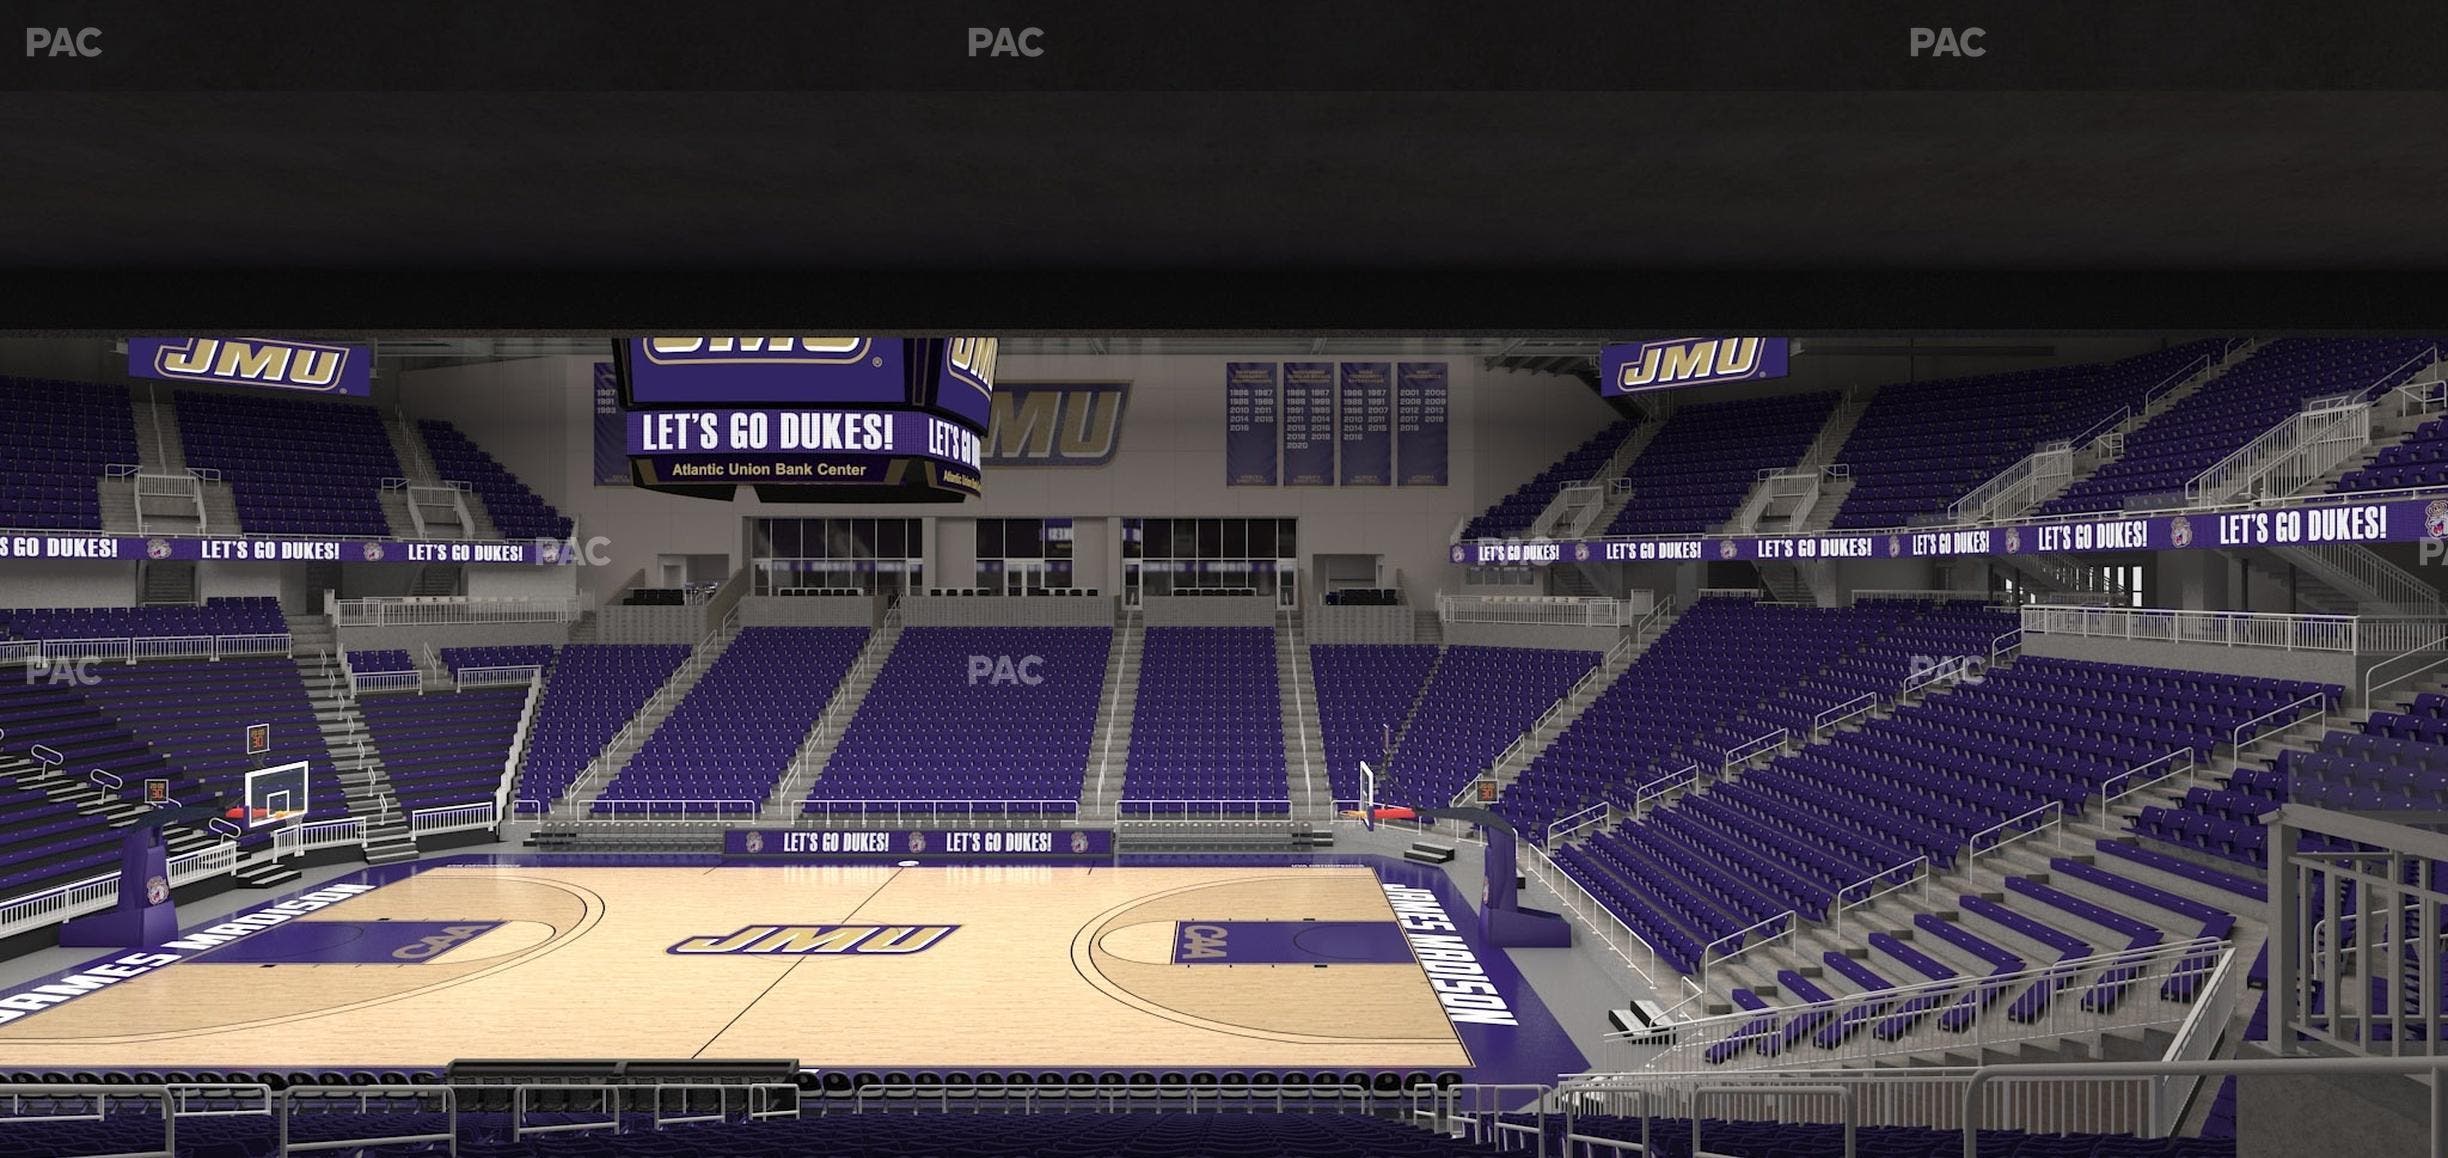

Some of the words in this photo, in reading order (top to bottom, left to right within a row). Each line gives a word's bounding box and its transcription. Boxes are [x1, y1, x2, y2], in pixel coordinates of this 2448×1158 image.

[163, 338, 340, 385] JMU
[1623, 337, 1759, 386] JMU
[1400, 389, 1419, 397] 2001
[1230, 415, 1249, 423] 2014
[1287, 415, 1304, 423] 2011
[1311, 415, 1330, 423] 2014
[1343, 415, 1363, 423] 2010
[1368, 415, 1385, 423] 2011
[1343, 424, 1363, 432] 2014
[1400, 415, 1418, 423] 2017
[643, 412, 718, 450] LET'S
[730, 412, 768, 450] GO
[780, 412, 893, 450] DUKES!
[928, 418, 959, 460] LET'S
[672, 462, 724, 477] Atlantic
[729, 463, 770, 476] Union
[775, 462, 813, 476] Bank
[817, 462, 867, 476] Center
[2219, 514, 2268, 544] LET'S
[2275, 511, 2301, 542] GO
[2309, 506, 2387, 541] DUKES!
[1912, 531, 1936, 555] LET'S
[1939, 531, 1952, 554] GO
[1954, 530, 1990, 553] DUKES!
[2038, 525, 2070, 551] LET'S
[2075, 523, 2093, 549] GO
[2096, 521, 2147, 549] DUKES!
[13, 537, 39, 557] GO
[47, 537, 118, 557] DUKES!
[202, 540, 247, 559] LET'S
[255, 541, 275, 559] GO
[282, 541, 340, 560] DUKES!
[408, 543, 446, 561] LET'S
[451, 544, 470, 561] GO
[474, 544, 522, 561] DUKES!
[1507, 545, 1520, 561] GO
[1523, 544, 1560, 560] DUKES!
[1607, 543, 1637, 559] LET'S
[1640, 543, 1654, 559] GO
[1659, 542, 1701, 559] DUKES!
[1758, 539, 1793, 558] LET'S
[1798, 539, 1816, 557] GO
[1820, 537, 1873, 557] DUKES!
[784, 832, 818, 851] LET'S
[823, 832, 839, 851] GO
[843, 832, 889, 851] DUKES!
[947, 832, 981, 851] LET'S
[985, 832, 1001, 851] GO
[1006, 832, 1052, 851] DUKES!
[162, 882, 376, 950] MADISON
[1382, 883, 1457, 931] JAMES
[391, 924, 493, 959] CAA
[675, 926, 957, 953] JMU
[1182, 925, 1228, 959] CAA
[1406, 933, 1520, 1026] MADISON
